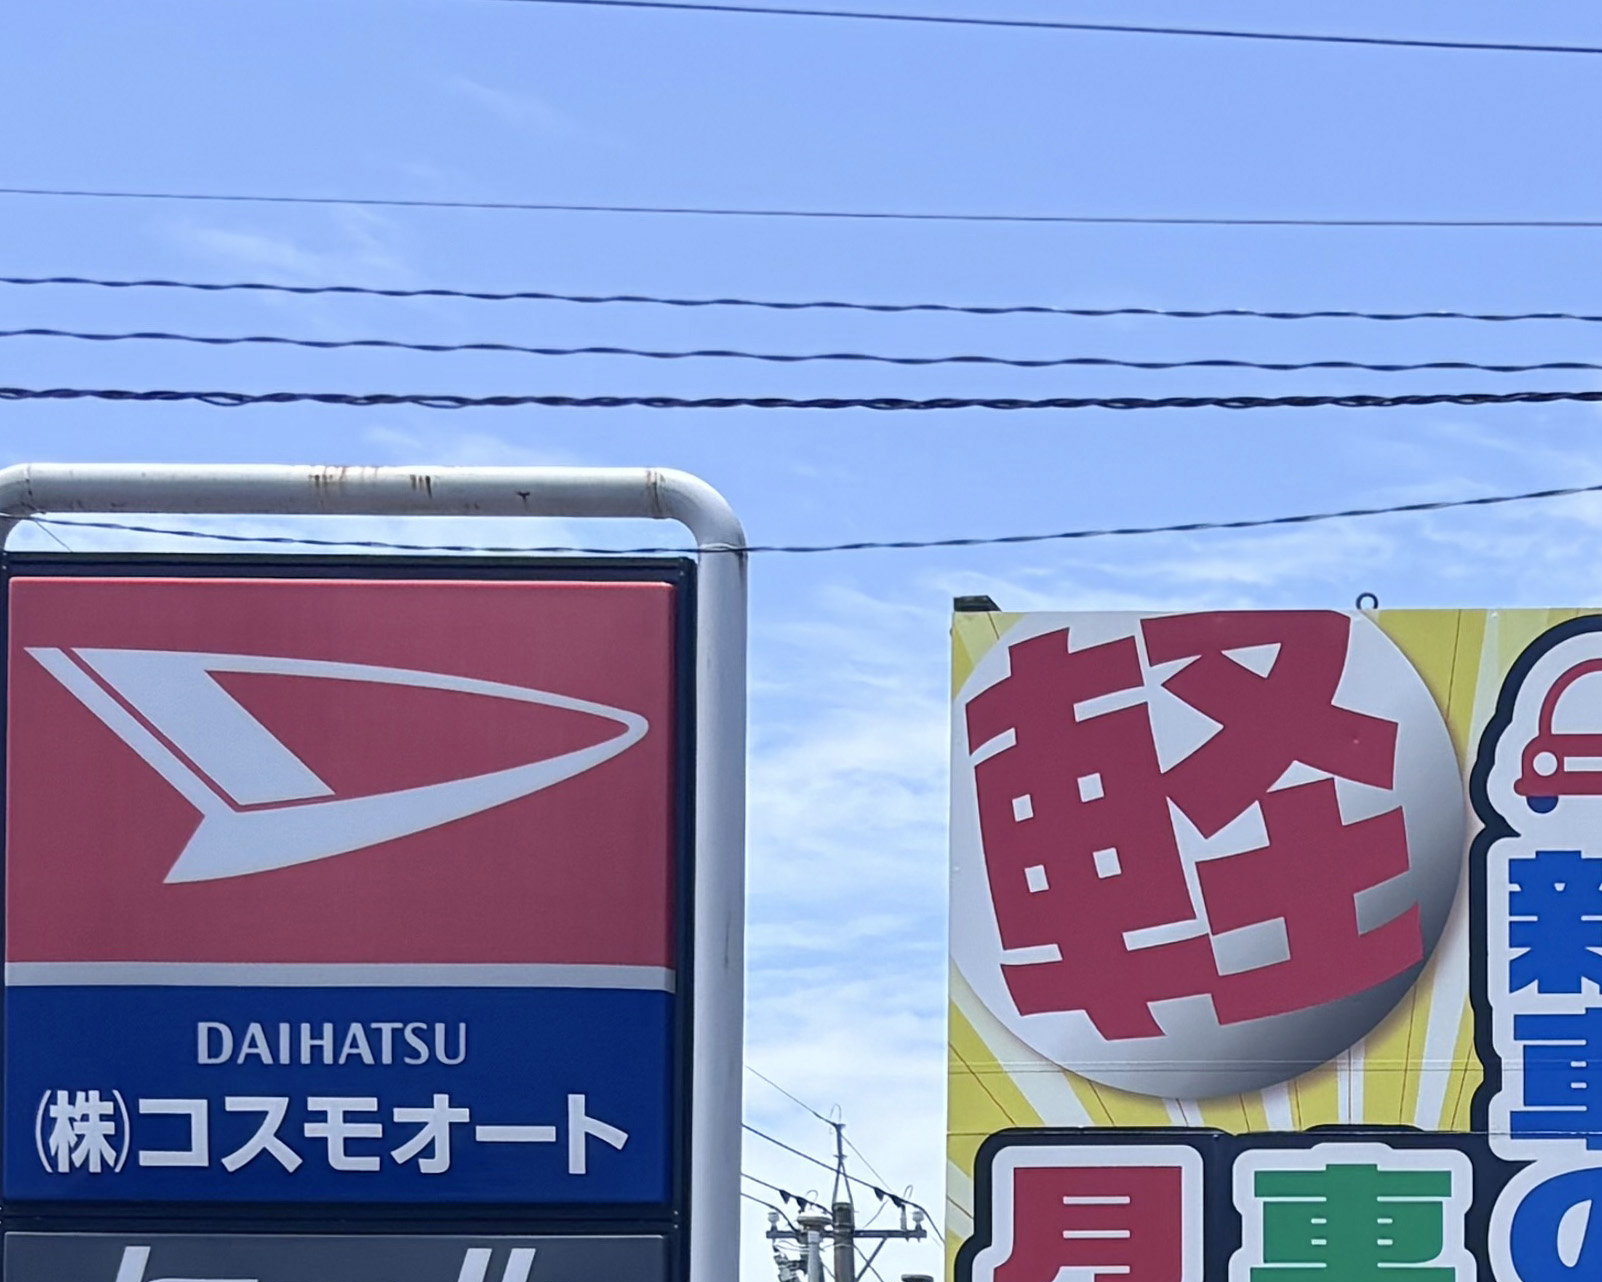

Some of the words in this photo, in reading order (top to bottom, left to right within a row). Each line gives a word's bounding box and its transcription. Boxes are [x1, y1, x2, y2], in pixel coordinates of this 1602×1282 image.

[966, 610, 1424, 1042] 軽
[196, 1022, 468, 1066] DAIHATSU
[35, 1088, 629, 1176] (株)コスモオート
